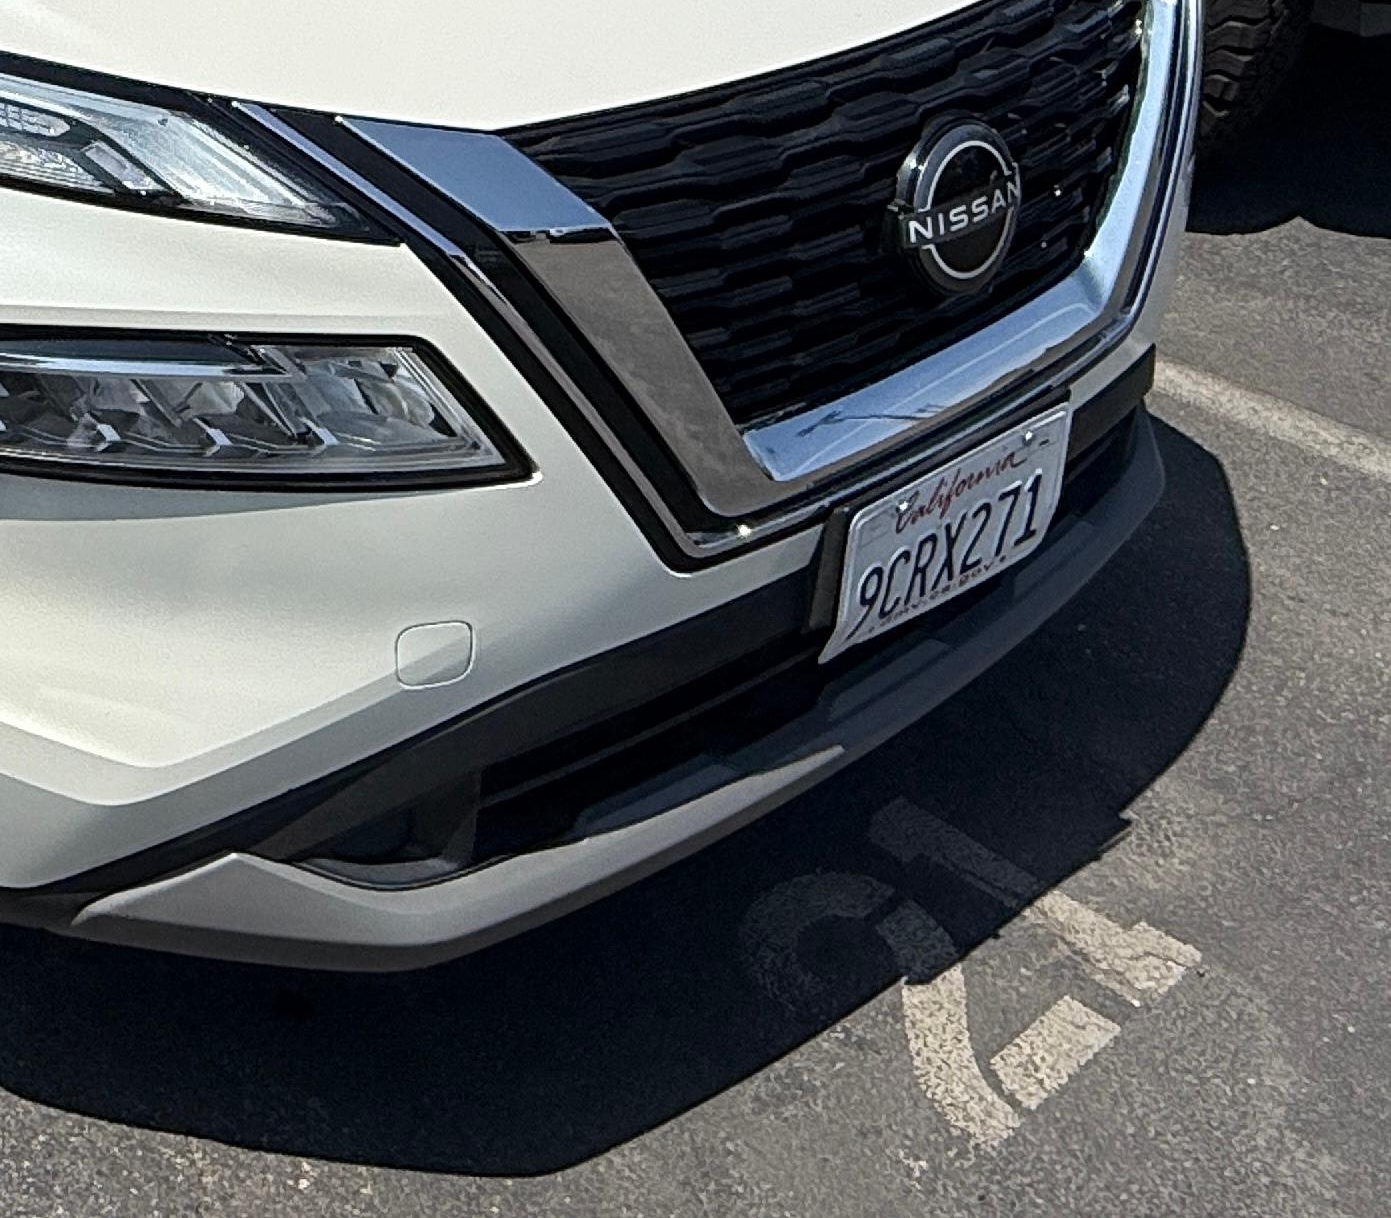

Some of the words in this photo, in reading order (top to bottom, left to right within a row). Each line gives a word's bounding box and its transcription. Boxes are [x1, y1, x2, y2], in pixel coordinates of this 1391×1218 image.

[909, 181, 1020, 243] NISSAN
[895, 451, 1027, 533] California
[846, 473, 1043, 641] 9CRX271
